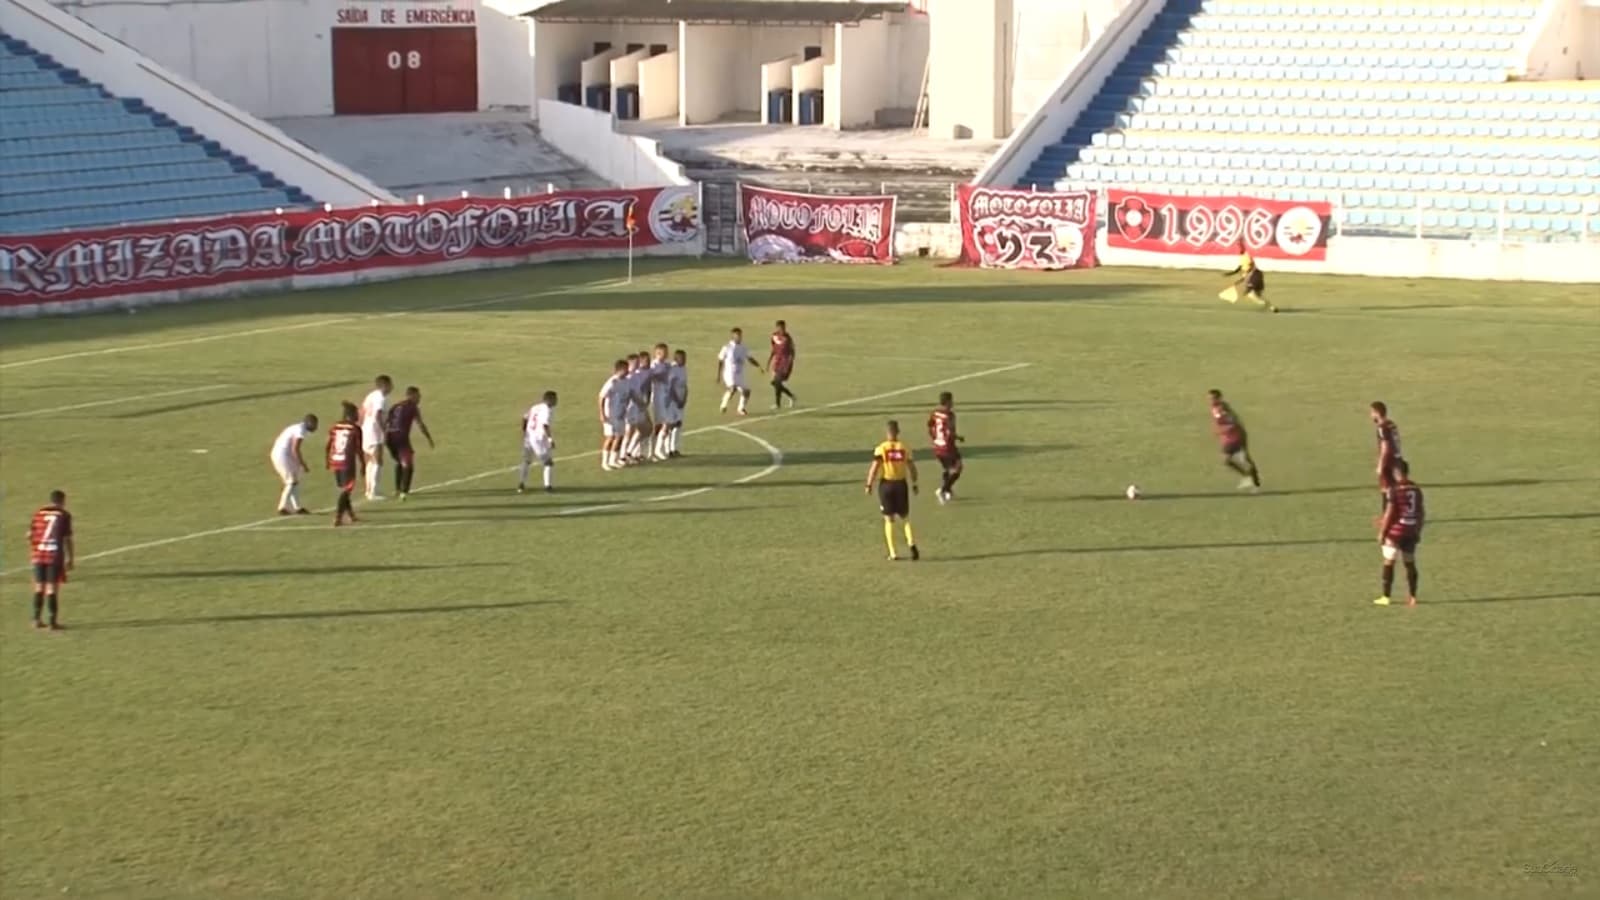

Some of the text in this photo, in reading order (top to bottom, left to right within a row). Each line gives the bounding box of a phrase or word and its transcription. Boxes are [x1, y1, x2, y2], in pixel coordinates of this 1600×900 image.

[380, 9, 396, 24] DE
[1160, 202, 1273, 249] 1996
[42, 514, 58, 542] 7
